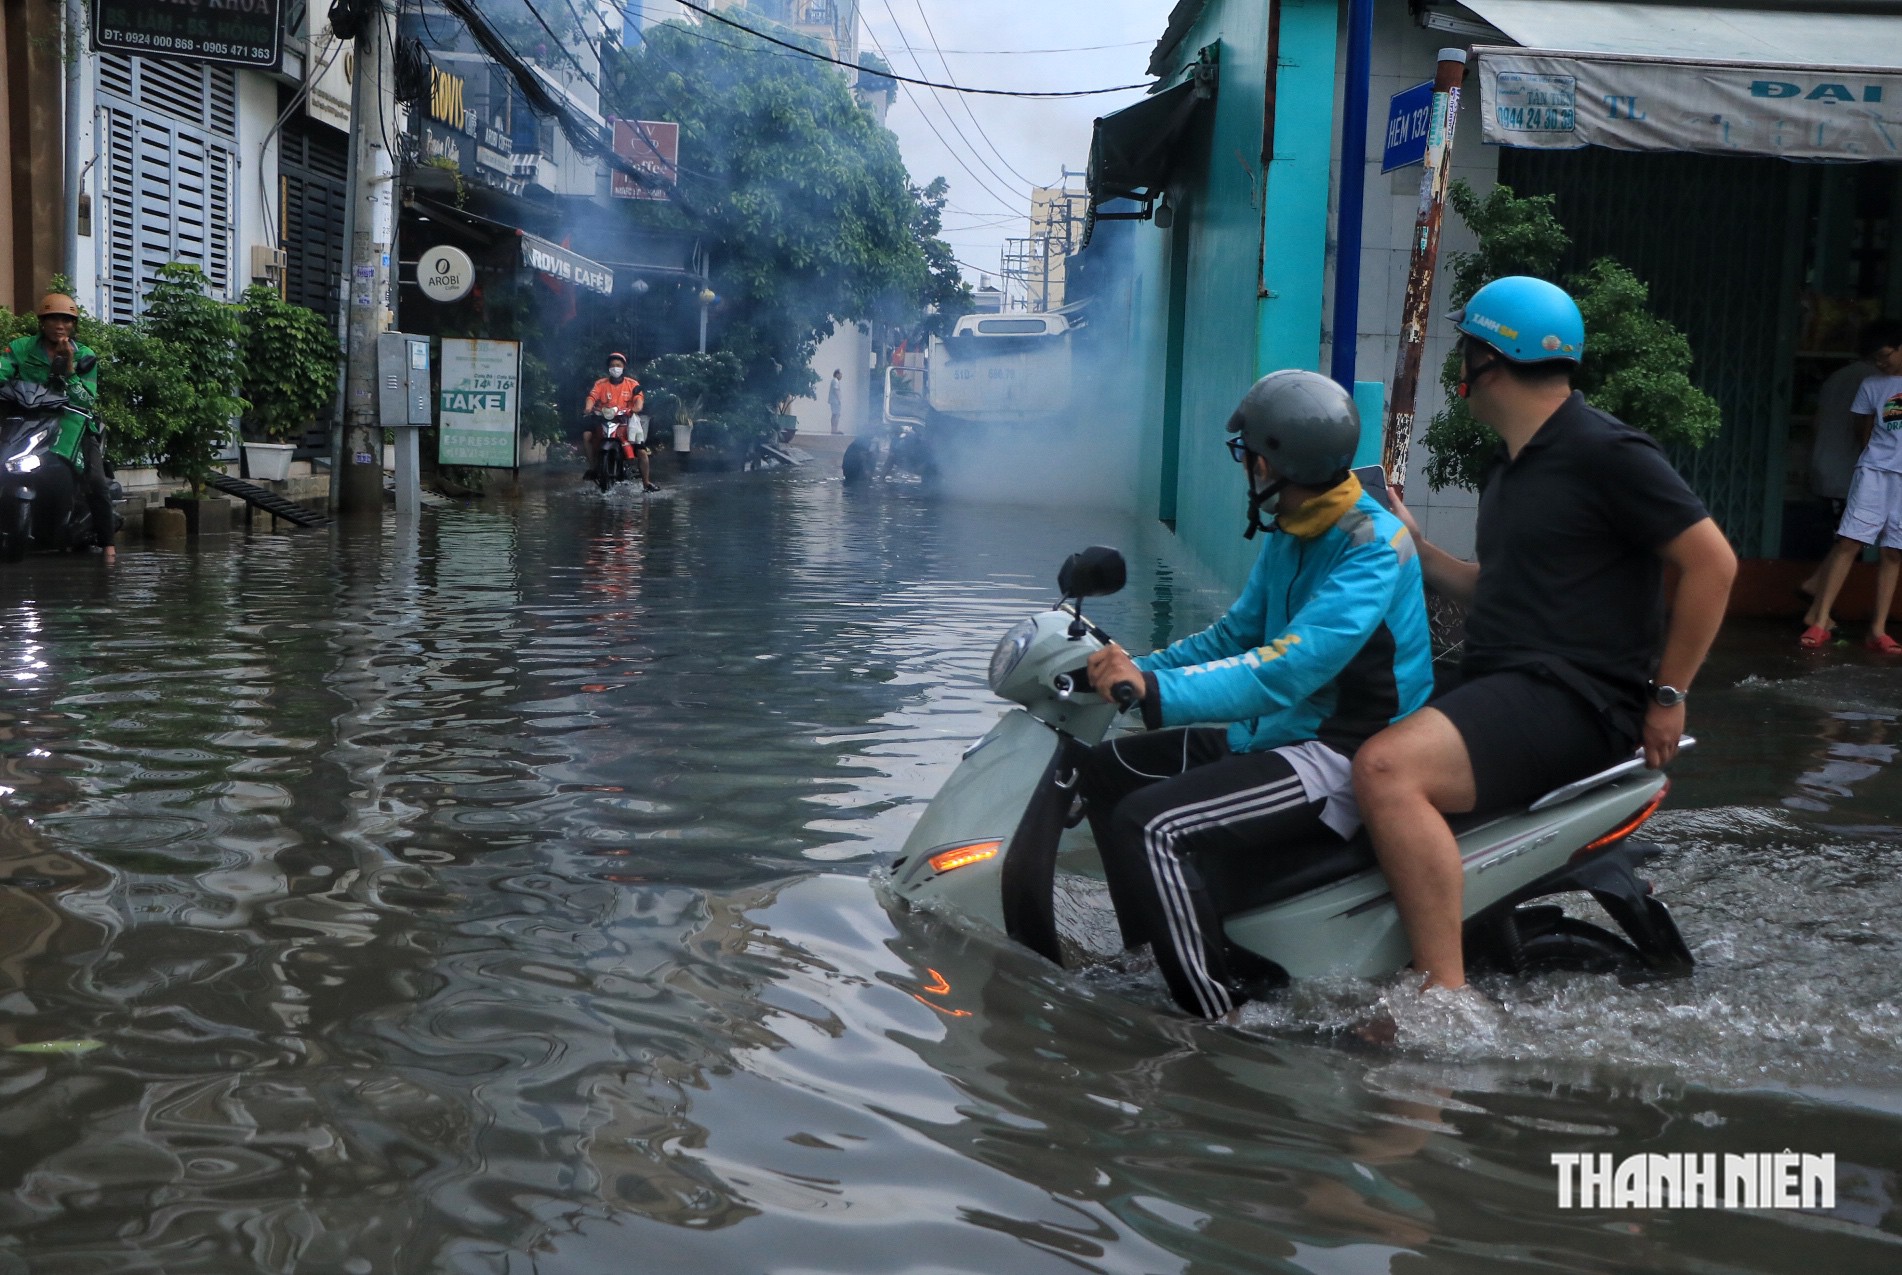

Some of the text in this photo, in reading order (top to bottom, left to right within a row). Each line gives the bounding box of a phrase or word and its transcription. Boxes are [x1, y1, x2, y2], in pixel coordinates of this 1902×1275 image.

[104, 29, 123, 41] ĐT:
[125, 32, 151, 45] 0924
[153, 35, 173, 48] 000
[174, 38, 194, 50] 868
[203, 41, 228, 54] 0905
[230, 45, 248, 57] 471
[251, 47, 270, 60] 363
[1747, 80, 1883, 105] ĐẠI
[1411, 105, 1430, 141] 132
[1498, 106, 1524, 129] 0944
[1526, 107, 1541, 129] 24
[1544, 108, 1558, 130] 30
[428, 274, 460, 287] AROBI
[532, 248, 604, 289] ROVIS CAFÉ
[442, 393, 502, 412] TAKE
[444, 435, 508, 446] ESPRESSO
